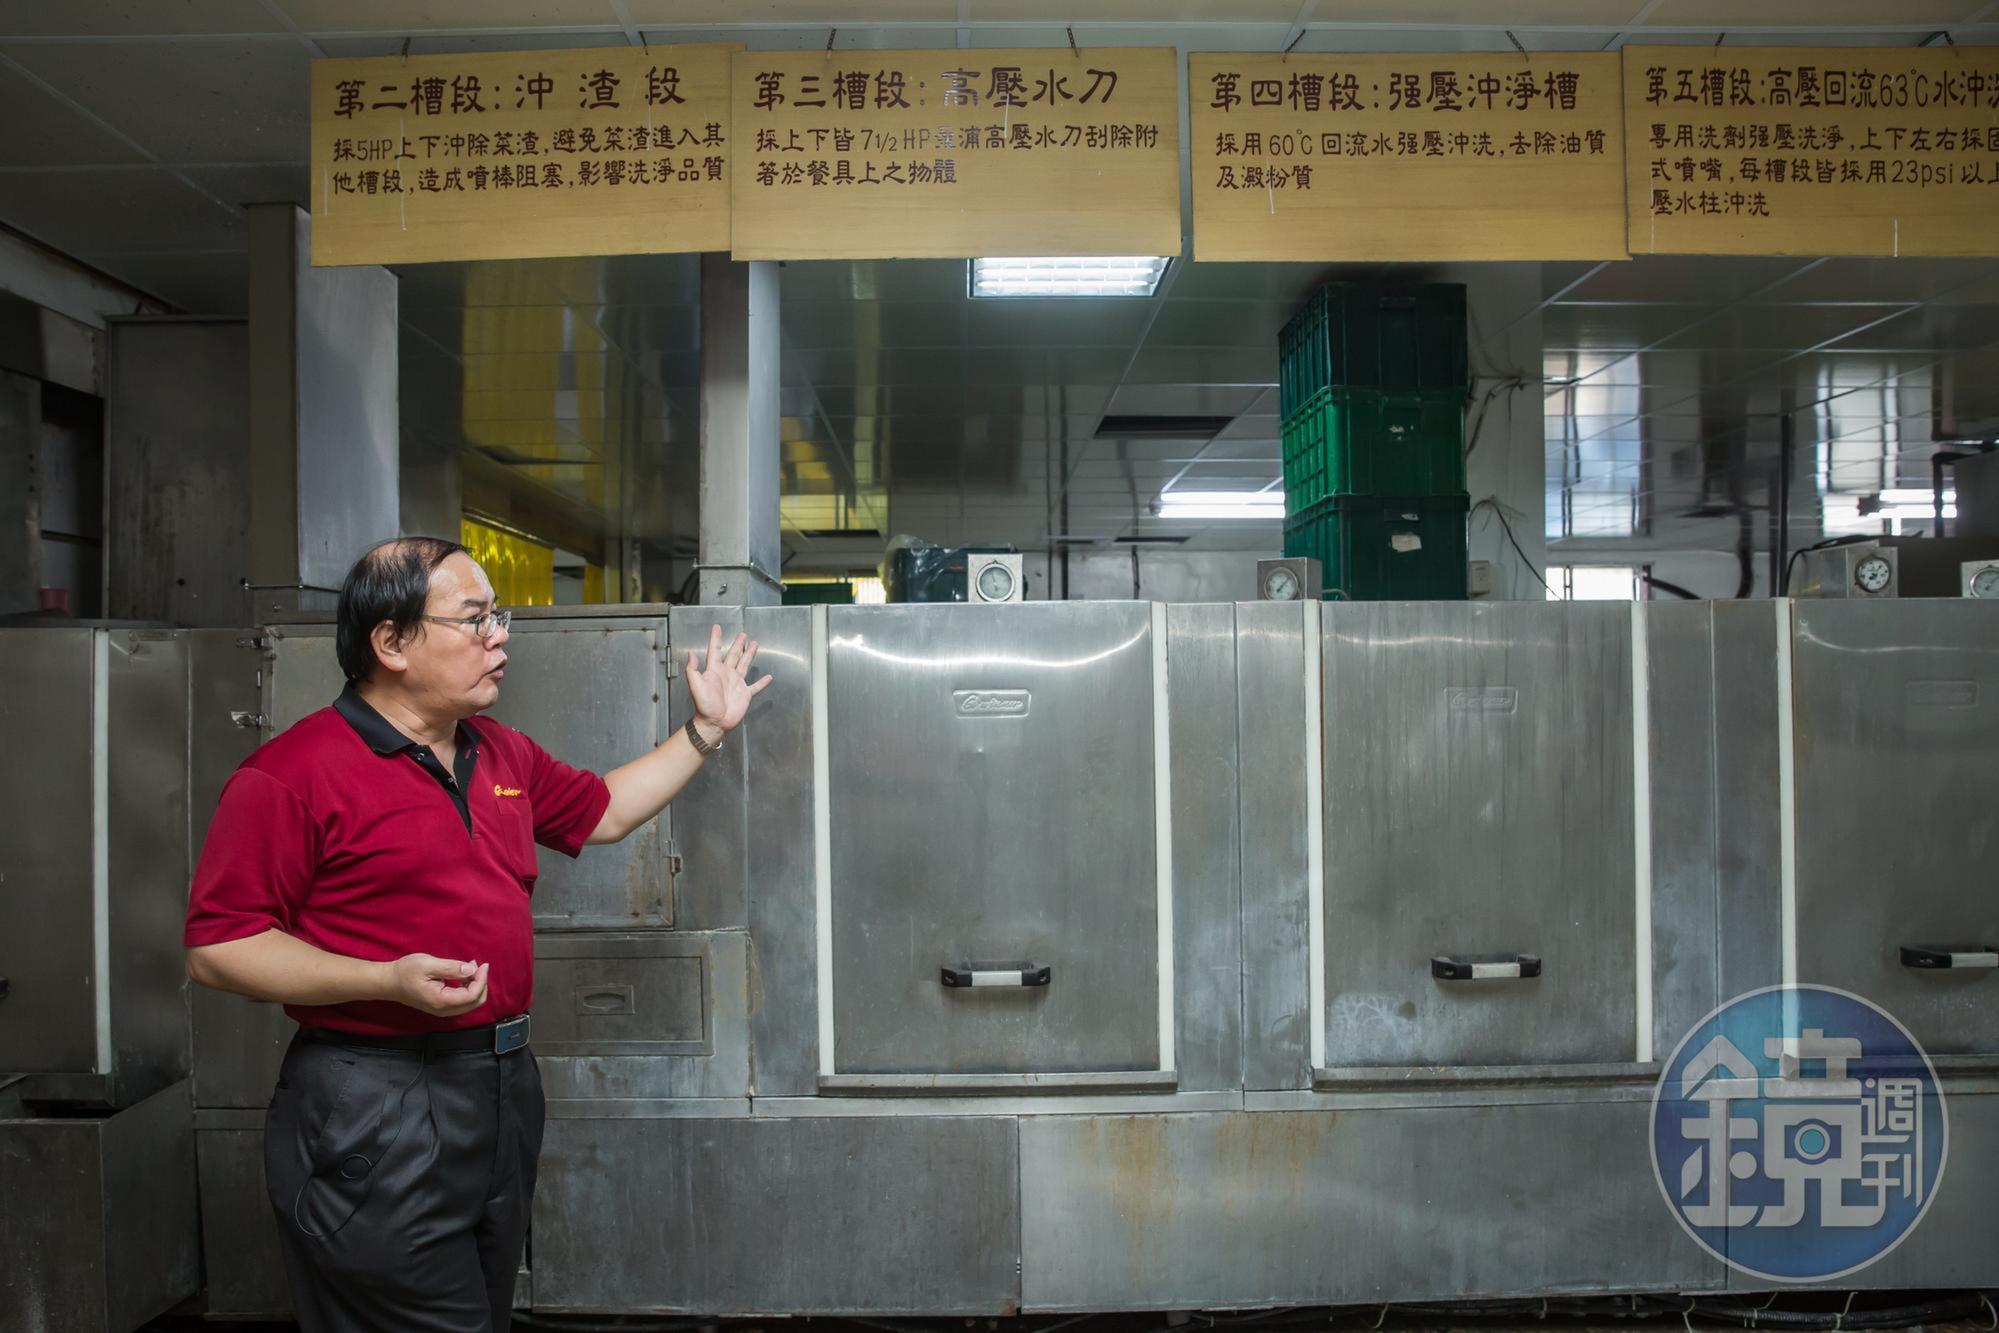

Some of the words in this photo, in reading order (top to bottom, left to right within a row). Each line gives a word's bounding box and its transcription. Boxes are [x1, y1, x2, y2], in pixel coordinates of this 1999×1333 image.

[1216, 165, 1314, 190] 及澱粉質
[1651, 189, 1771, 217] 壓水柱沖洗
